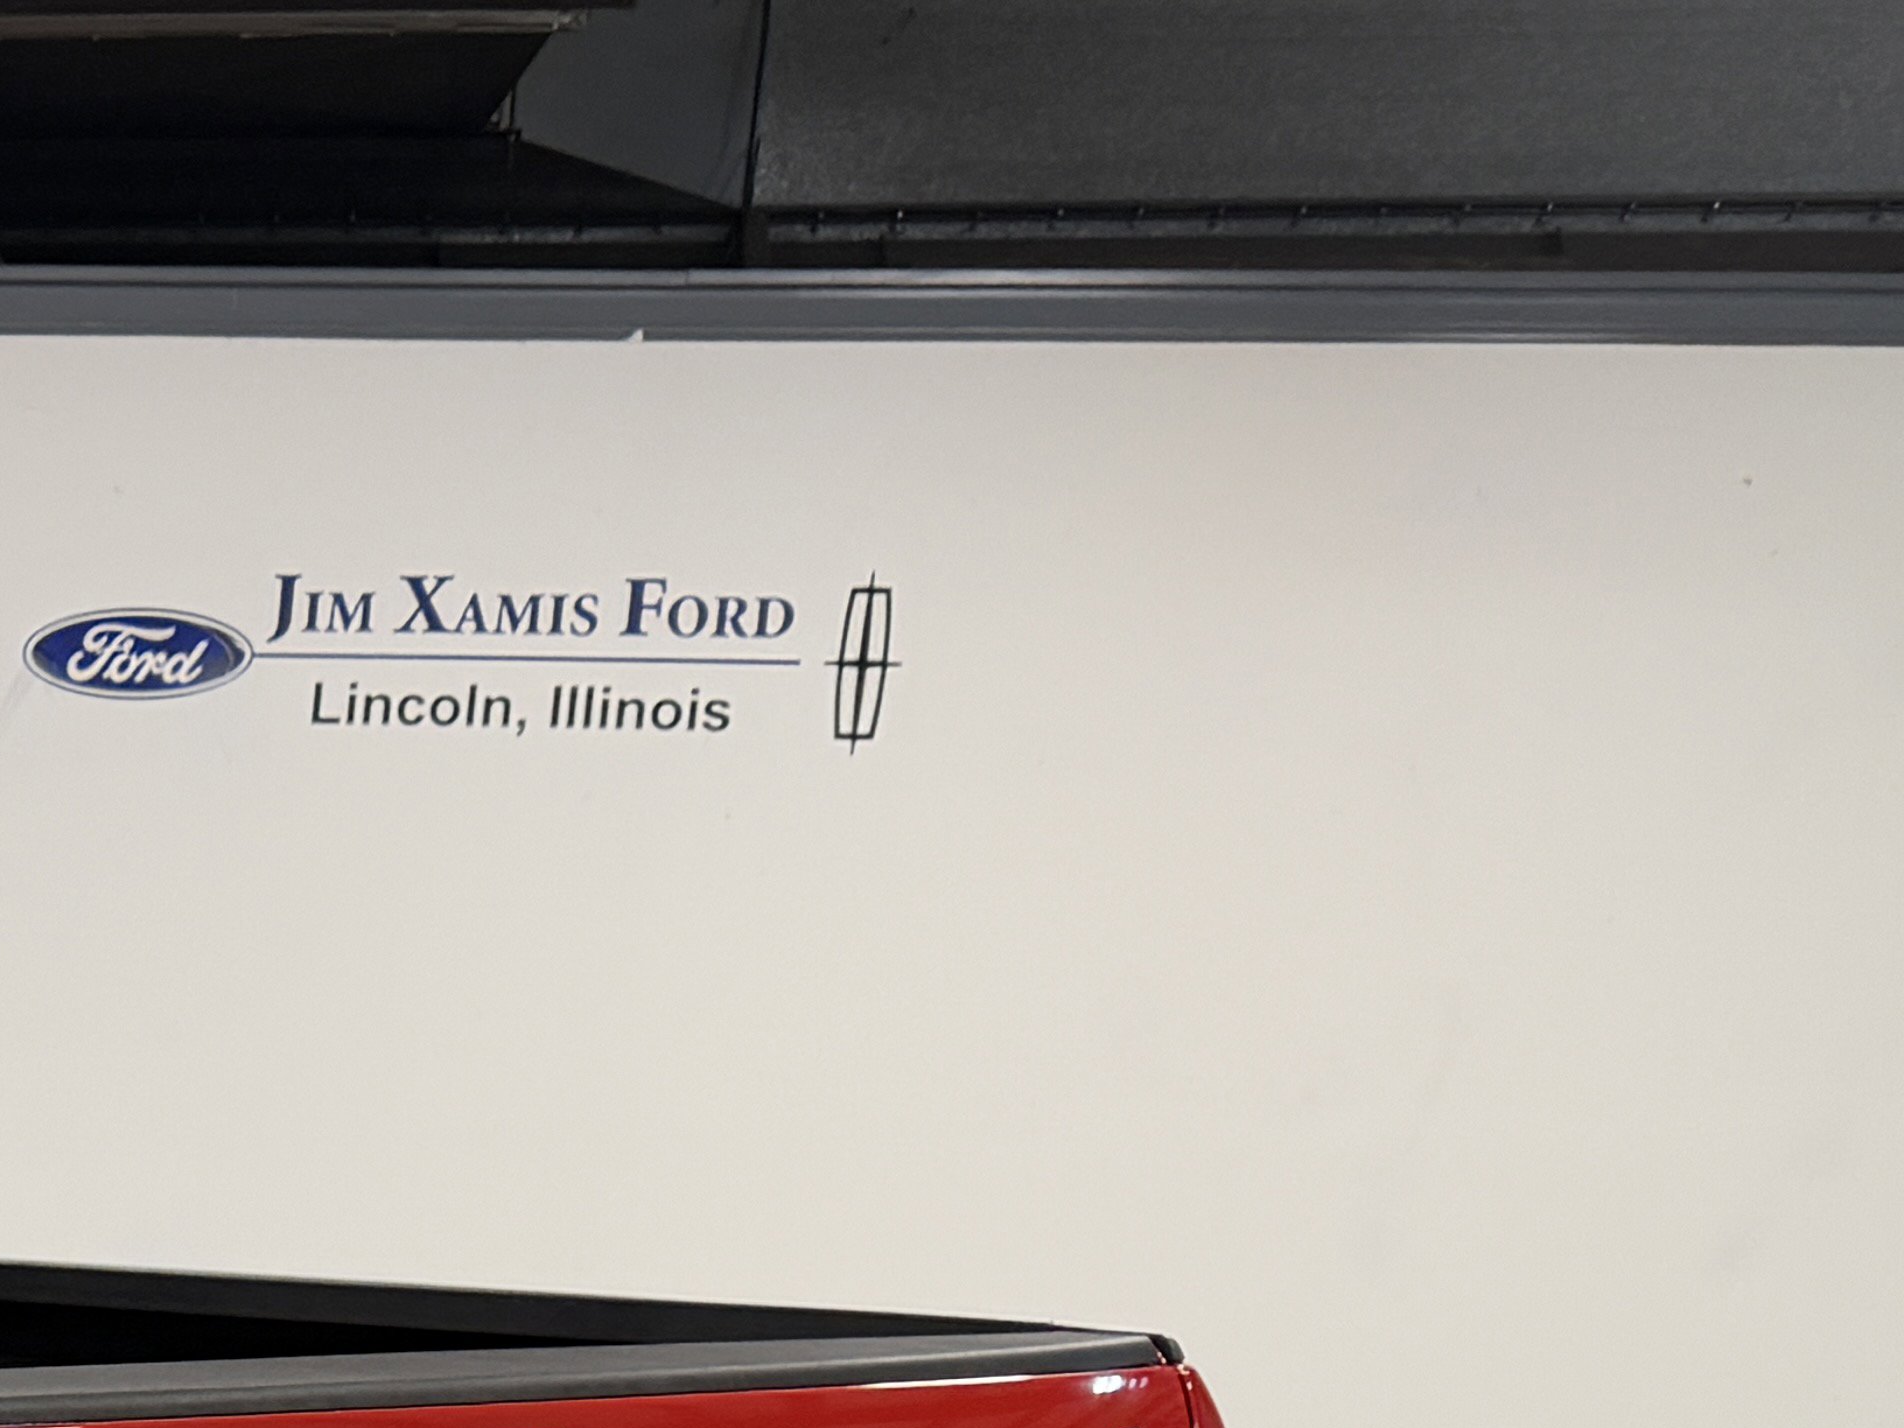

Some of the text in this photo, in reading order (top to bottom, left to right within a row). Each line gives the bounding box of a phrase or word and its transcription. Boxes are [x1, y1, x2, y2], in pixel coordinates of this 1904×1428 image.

[268, 573, 795, 644] JIM XAMIS FORD
[65, 621, 205, 685] Ford
[311, 682, 732, 736] Lincoln, Illinois
